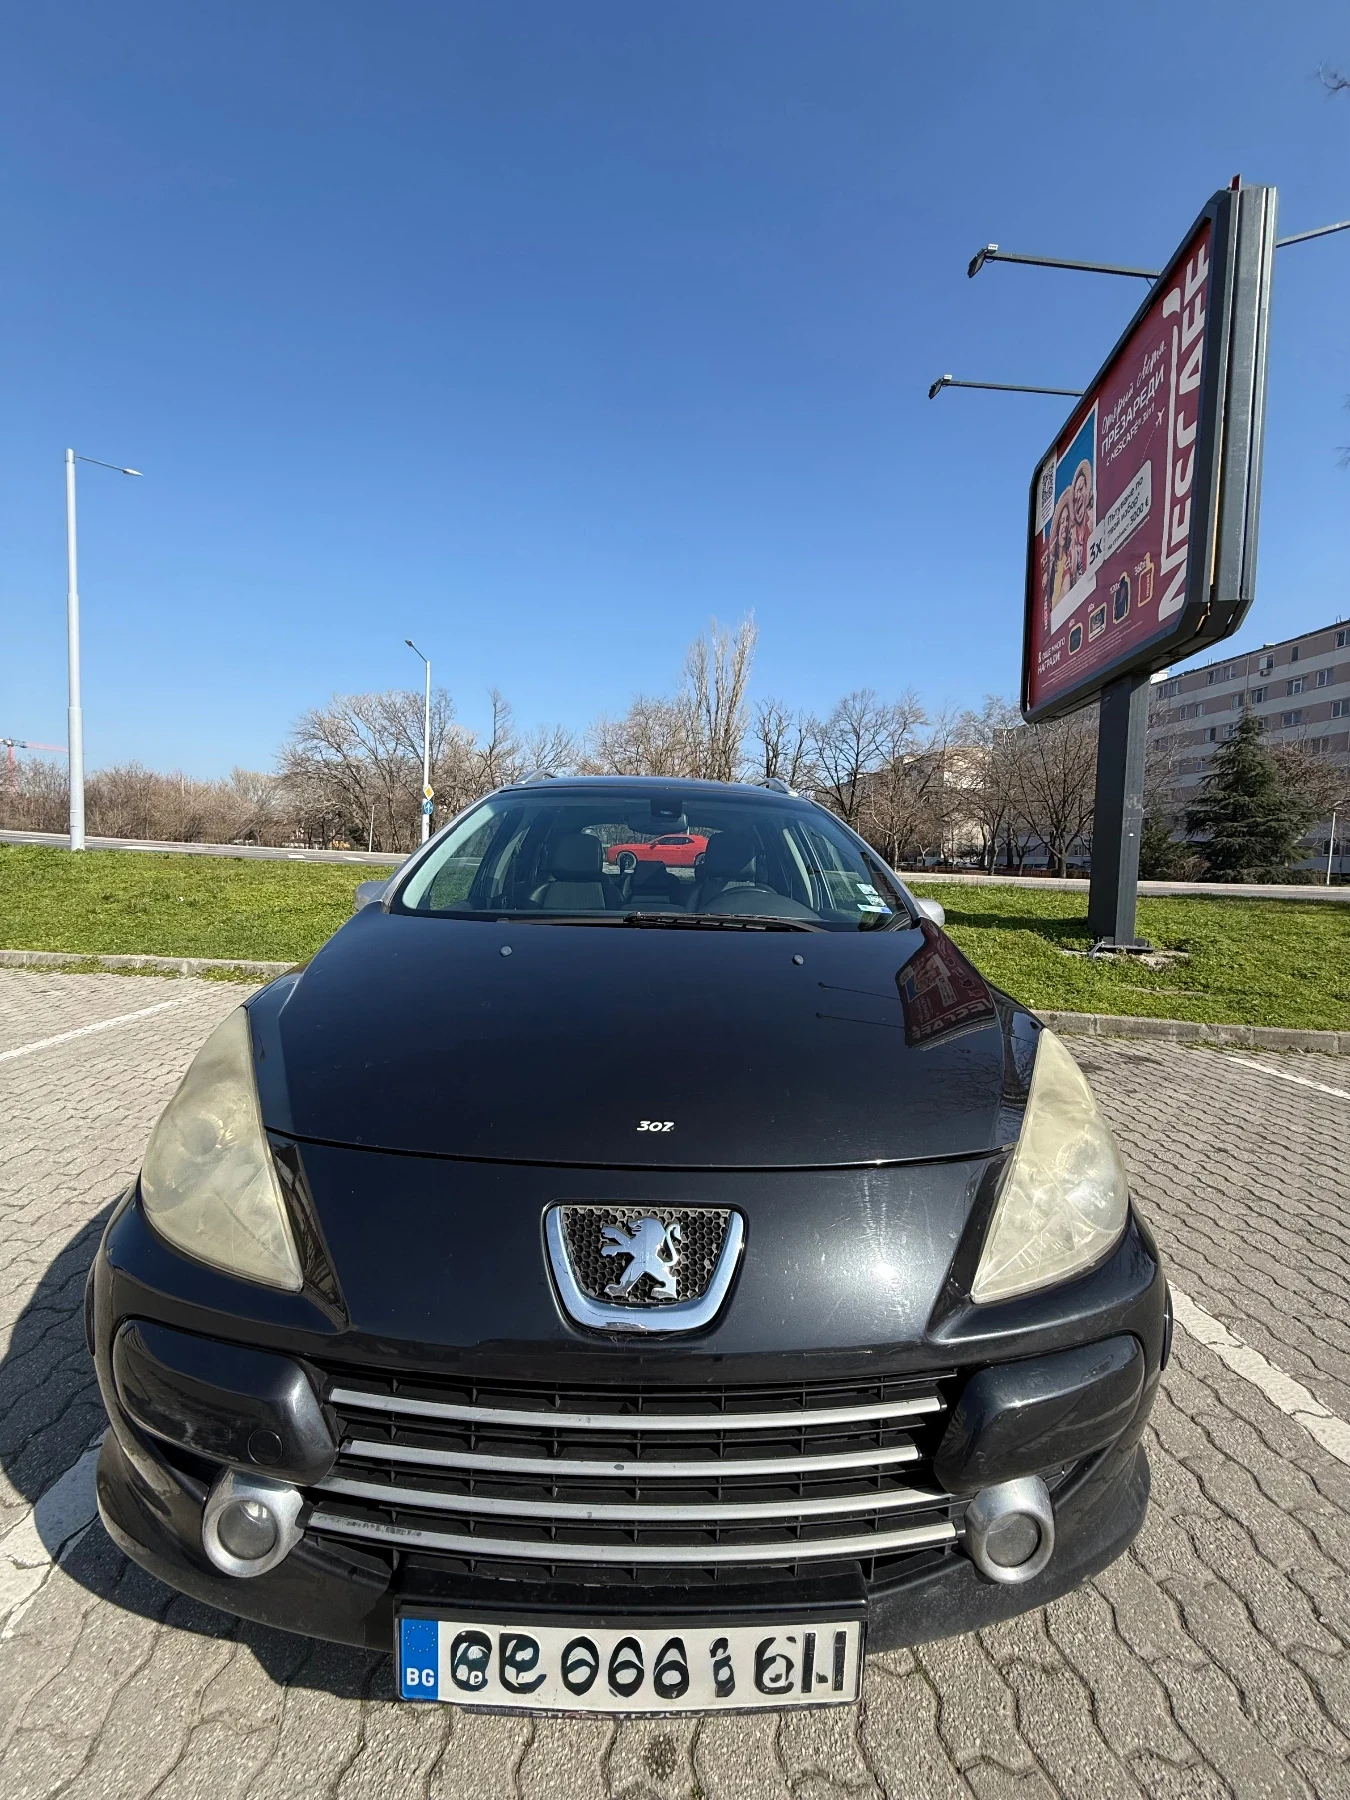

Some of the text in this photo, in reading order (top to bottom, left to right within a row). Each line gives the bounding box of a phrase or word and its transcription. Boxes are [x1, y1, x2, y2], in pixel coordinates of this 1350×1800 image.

[1101, 363, 1165, 458] ПРЕЗАРЕДИ
[1051, 637, 1066, 651] МНОГО
[406, 1668, 437, 1686] BG
